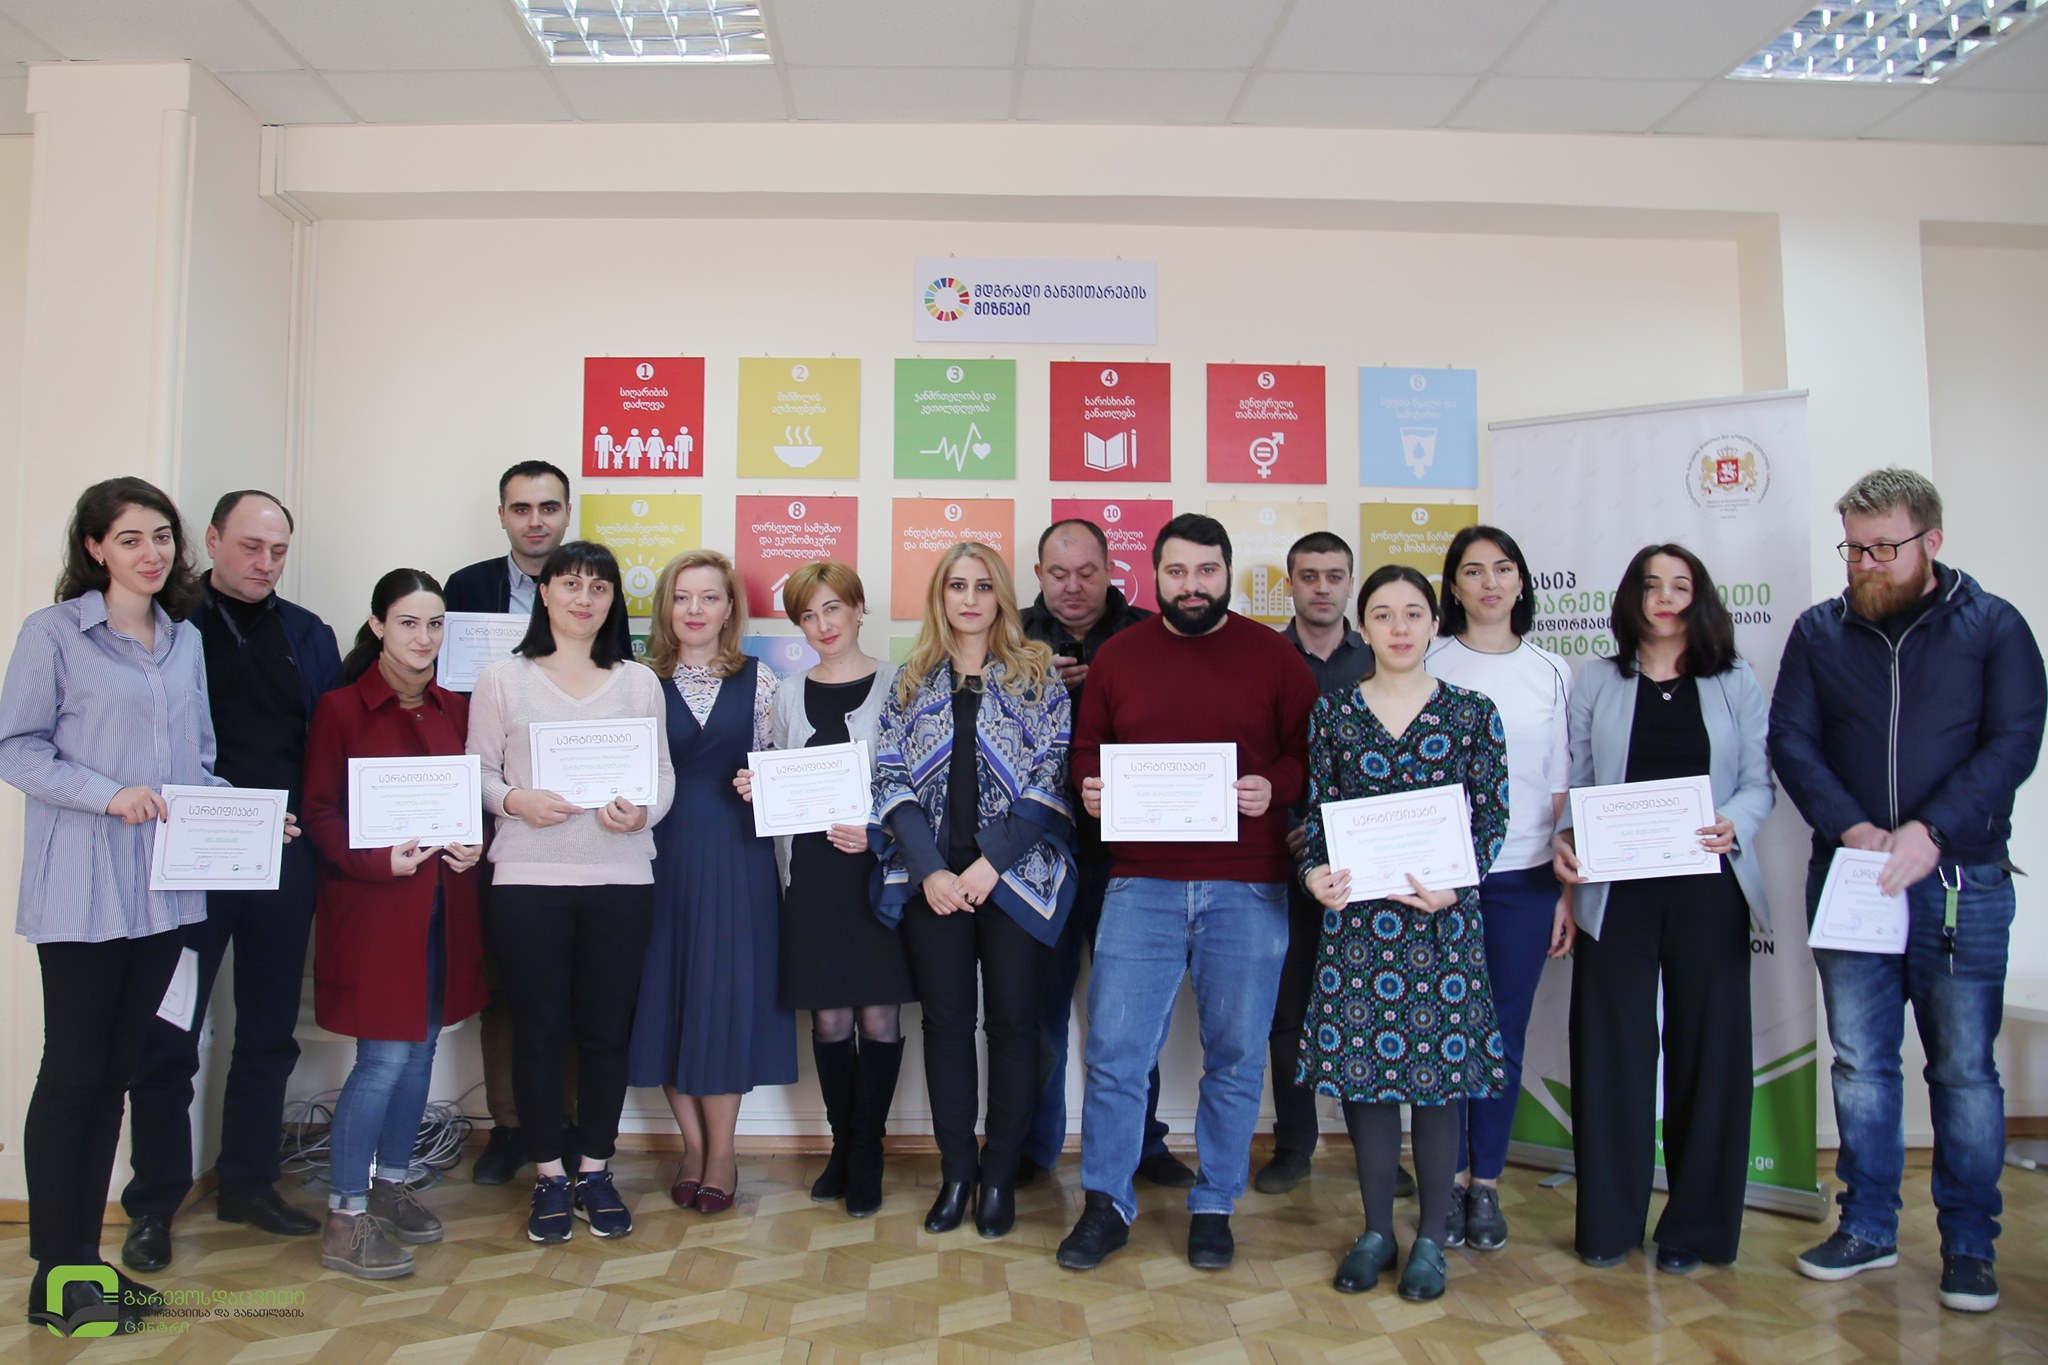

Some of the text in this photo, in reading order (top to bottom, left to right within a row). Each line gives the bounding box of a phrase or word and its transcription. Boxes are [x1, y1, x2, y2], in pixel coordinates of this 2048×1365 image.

[974, 284, 1147, 300] მდგრადი განვითარების
[974, 302, 1031, 316] მიზნები
[641, 365, 650, 378] 1
[796, 366, 805, 380] 2
[951, 367, 960, 381] 3
[1104, 371, 1114, 385] 4
[1262, 373, 1271, 387] 5
[1414, 375, 1423, 389] 6
[620, 387, 668, 399] სიღარიბის
[914, 391, 996, 403] ჯანმრთელობა და
[623, 399, 665, 410] დაძლევა
[1084, 396, 1135, 406] ხარისხიანი
[1239, 398, 1294, 410] გენდერული
[920, 403, 990, 415] კეთილდღეობა
[1084, 408, 1136, 420] განათლება
[1235, 409, 1298, 420] თანასწორობა
[636, 501, 644, 515] 7
[792, 503, 801, 517] 8
[949, 505, 958, 519] 9
[1107, 509, 1119, 518] 10
[1263, 511, 1273, 522] 11
[1414, 511, 1426, 522] 12
[752, 523, 841, 534] ღირსეული სამუშაო
[904, 528, 1002, 540] ინდუსტრია, ინოვაცია
[759, 535, 837, 547] და ეკონომიკური
[1426, 530, 1455, 542] წარმო
[904, 541, 918, 552] და
[1107, 540, 1147, 551] წორობა
[1389, 543, 1449, 555] და მოხმარებ
[761, 548, 831, 559] კეთილდღეობა
[632, 642, 645, 653] 13
[556, 733, 632, 746] სერტიფიკატი
[378, 772, 452, 783] სერტიფიკატი
[1603, 796, 1681, 813] სერტიფიკატი
[188, 805, 259, 817] სერტიფიკატი
